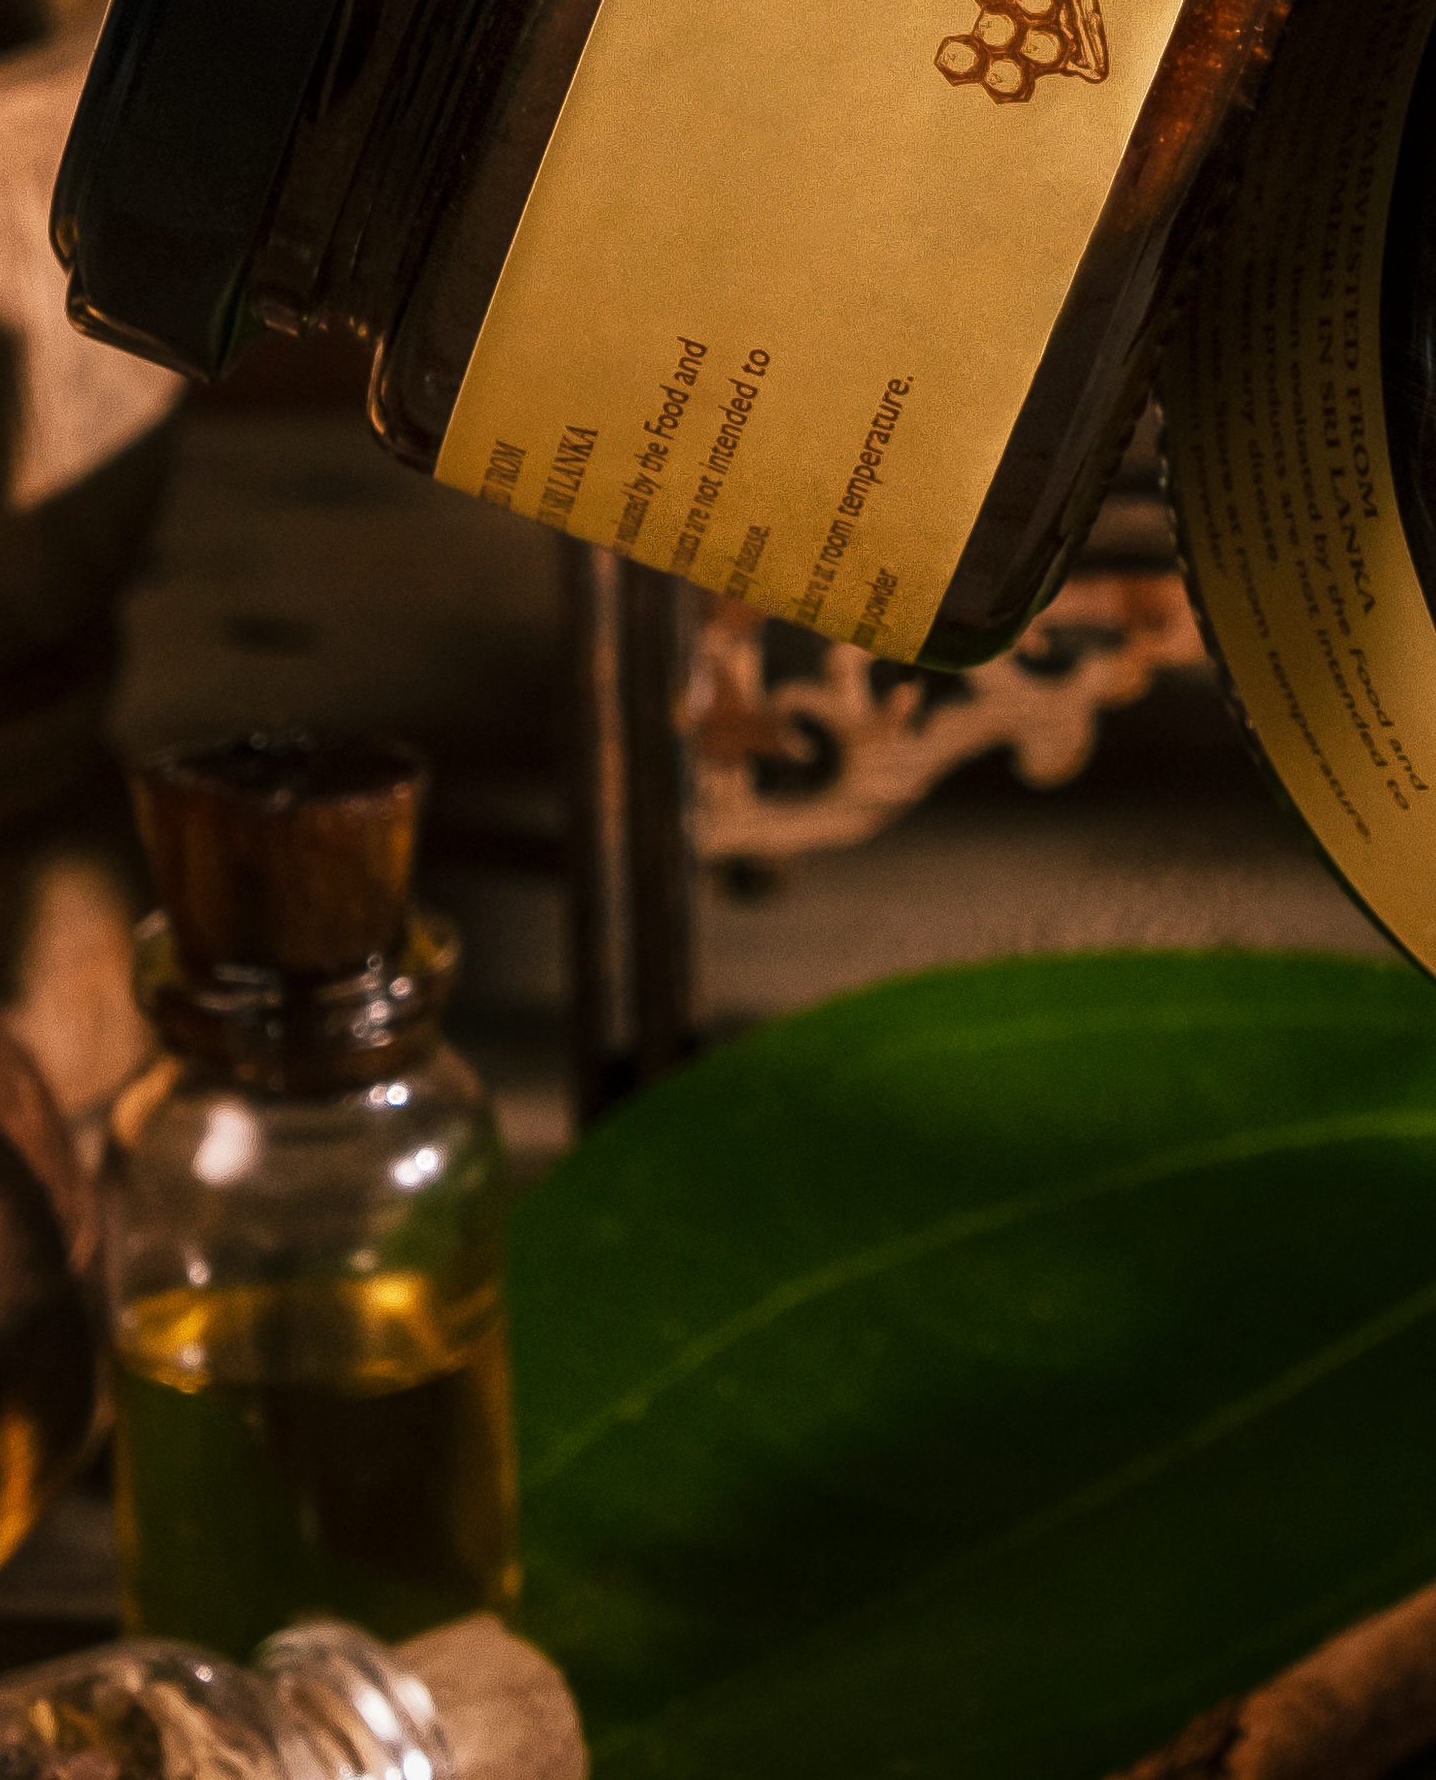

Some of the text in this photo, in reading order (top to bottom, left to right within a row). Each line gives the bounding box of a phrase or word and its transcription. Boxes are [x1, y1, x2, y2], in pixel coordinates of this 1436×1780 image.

[676, 335, 709, 387] and
[643, 383, 690, 441] Food
[697, 377, 759, 475] intended
[740, 348, 771, 377] to
[548, 424, 599, 493] LANKA
[634, 441, 670, 472] the
[836, 375, 915, 519] temperature.
[819, 519, 856, 566] room
